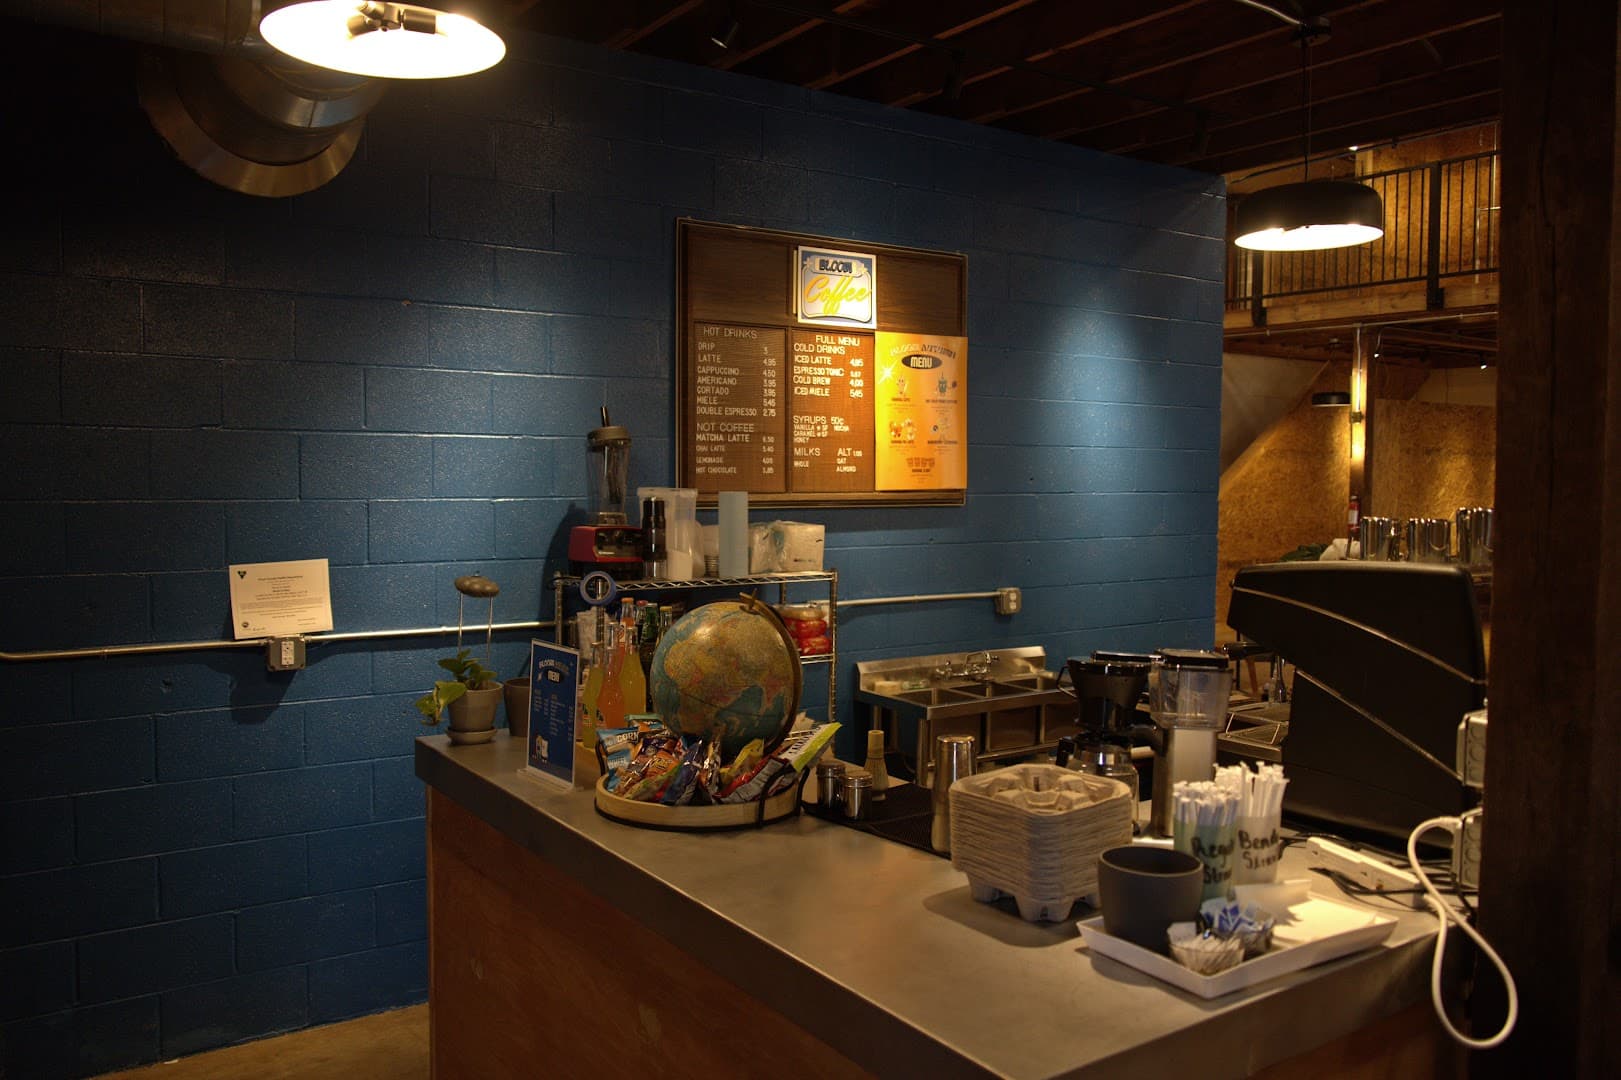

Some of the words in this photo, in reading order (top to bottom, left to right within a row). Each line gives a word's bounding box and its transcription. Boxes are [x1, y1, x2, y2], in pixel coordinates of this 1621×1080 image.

[804, 274, 872, 315] Coffee
[703, 326, 720, 337] HOT
[724, 328, 758, 339] DRINKS
[816, 335, 836, 344] FULL
[838, 336, 860, 346] MENU
[698, 342, 715, 351] DRIP
[794, 343, 814, 352] COLD
[817, 344, 846, 355] DRINKS
[698, 354, 721, 364] LATTE
[794, 355, 810, 364] ICED
[811, 356, 832, 365] LATTE
[910, 356, 932, 368] MENU
[697, 366, 740, 376] CAPPUCCINO
[794, 366, 825, 375] ESPRESSO
[826, 368, 844, 376] TONIC
[697, 376, 737, 386] AMERICANO
[793, 375, 811, 384] COLD
[812, 376, 831, 385] BREW
[696, 386, 730, 395] CORTADO
[794, 386, 808, 395] ICED
[809, 387, 830, 396] MIELE
[696, 396, 718, 405] MIELE
[696, 406, 723, 415] DOUBLE
[724, 408, 757, 416] ESPRESSO
[793, 415, 827, 424] SYRUPS
[696, 422, 716, 432] NOT
[720, 423, 755, 433] COFFEE
[696, 434, 723, 442] MATCHA
[728, 434, 750, 442] LATTE
[794, 448, 821, 456] MILKS
[837, 448, 852, 457] ALT
